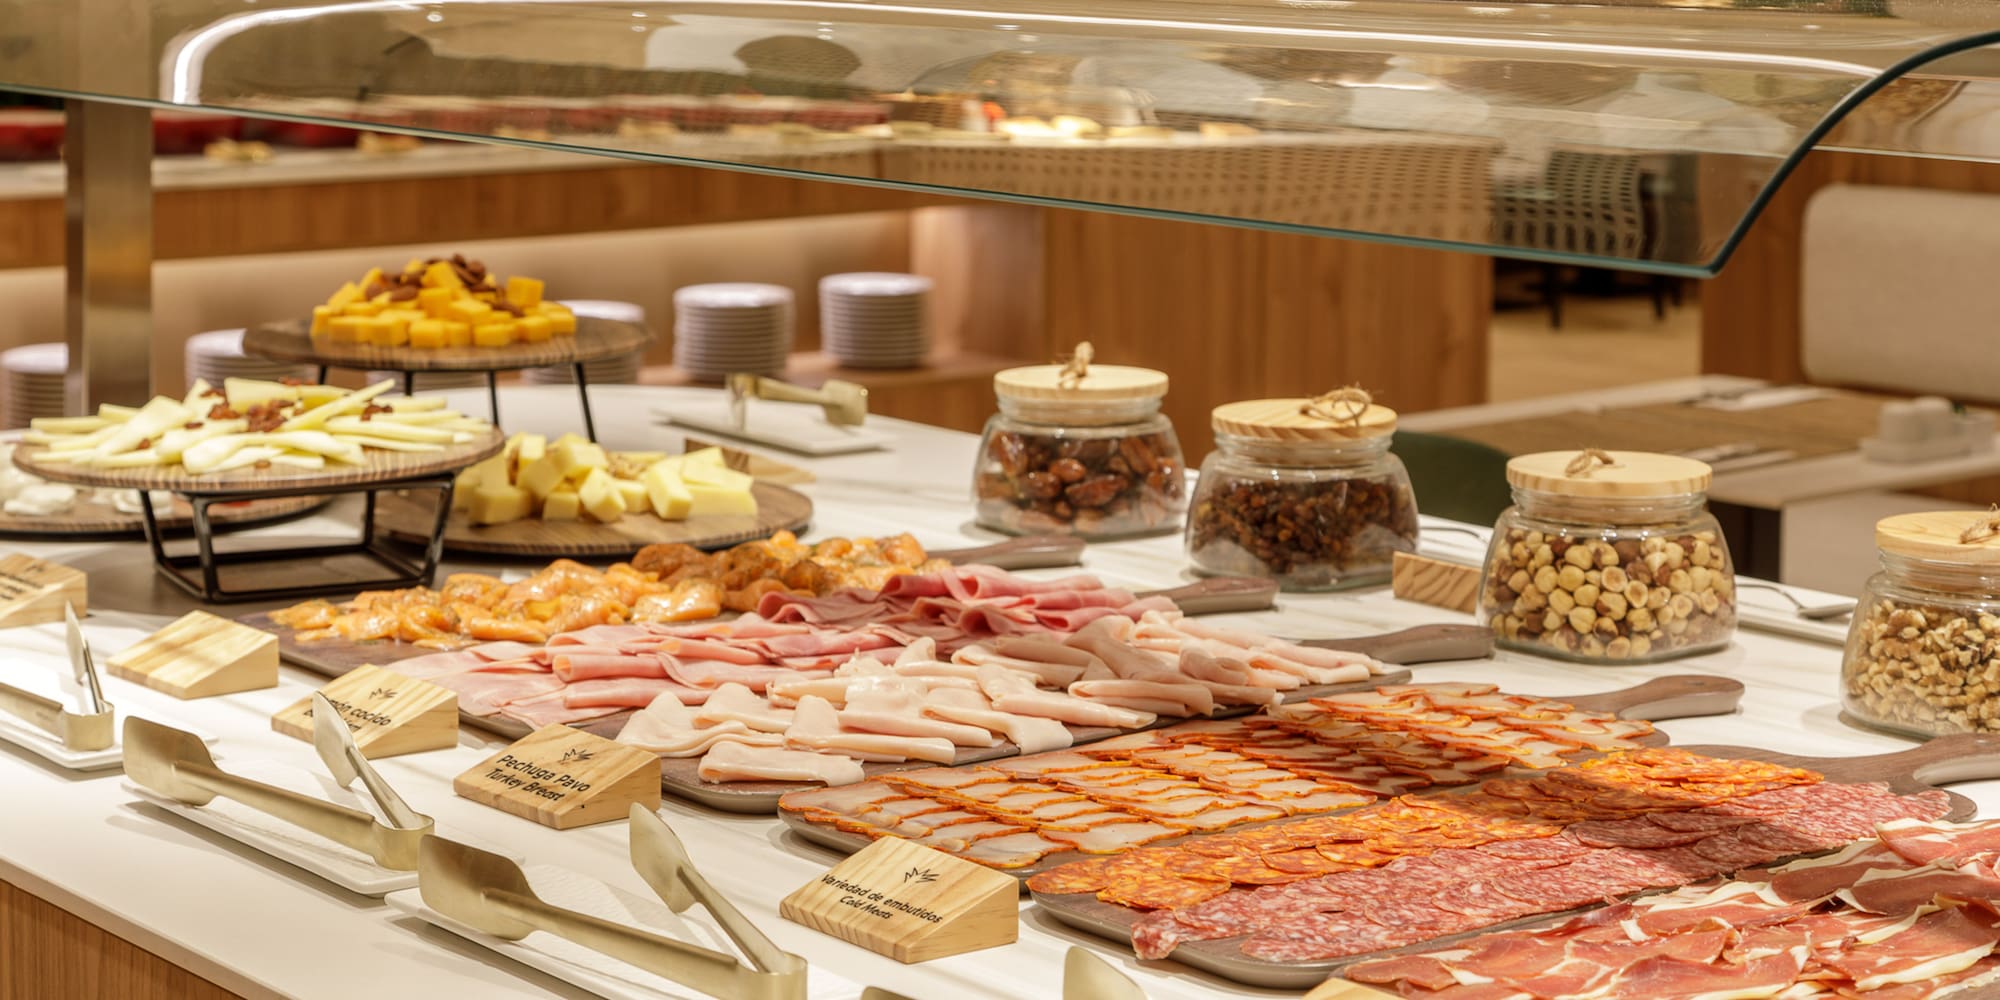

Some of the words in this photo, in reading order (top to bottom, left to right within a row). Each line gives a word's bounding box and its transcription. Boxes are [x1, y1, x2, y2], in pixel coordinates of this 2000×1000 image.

[350, 708, 391, 726] cocido
[485, 768, 525, 789] Turkey
[522, 781, 565, 801] Breast
[496, 754, 557, 780] Pechuga
[553, 774, 591, 792] Pavo
[821, 874, 871, 896] Variedad
[867, 892, 884, 902] de
[883, 898, 943, 923] embutidos
[840, 895, 865, 908] Cold
[861, 903, 893, 919] Meats
